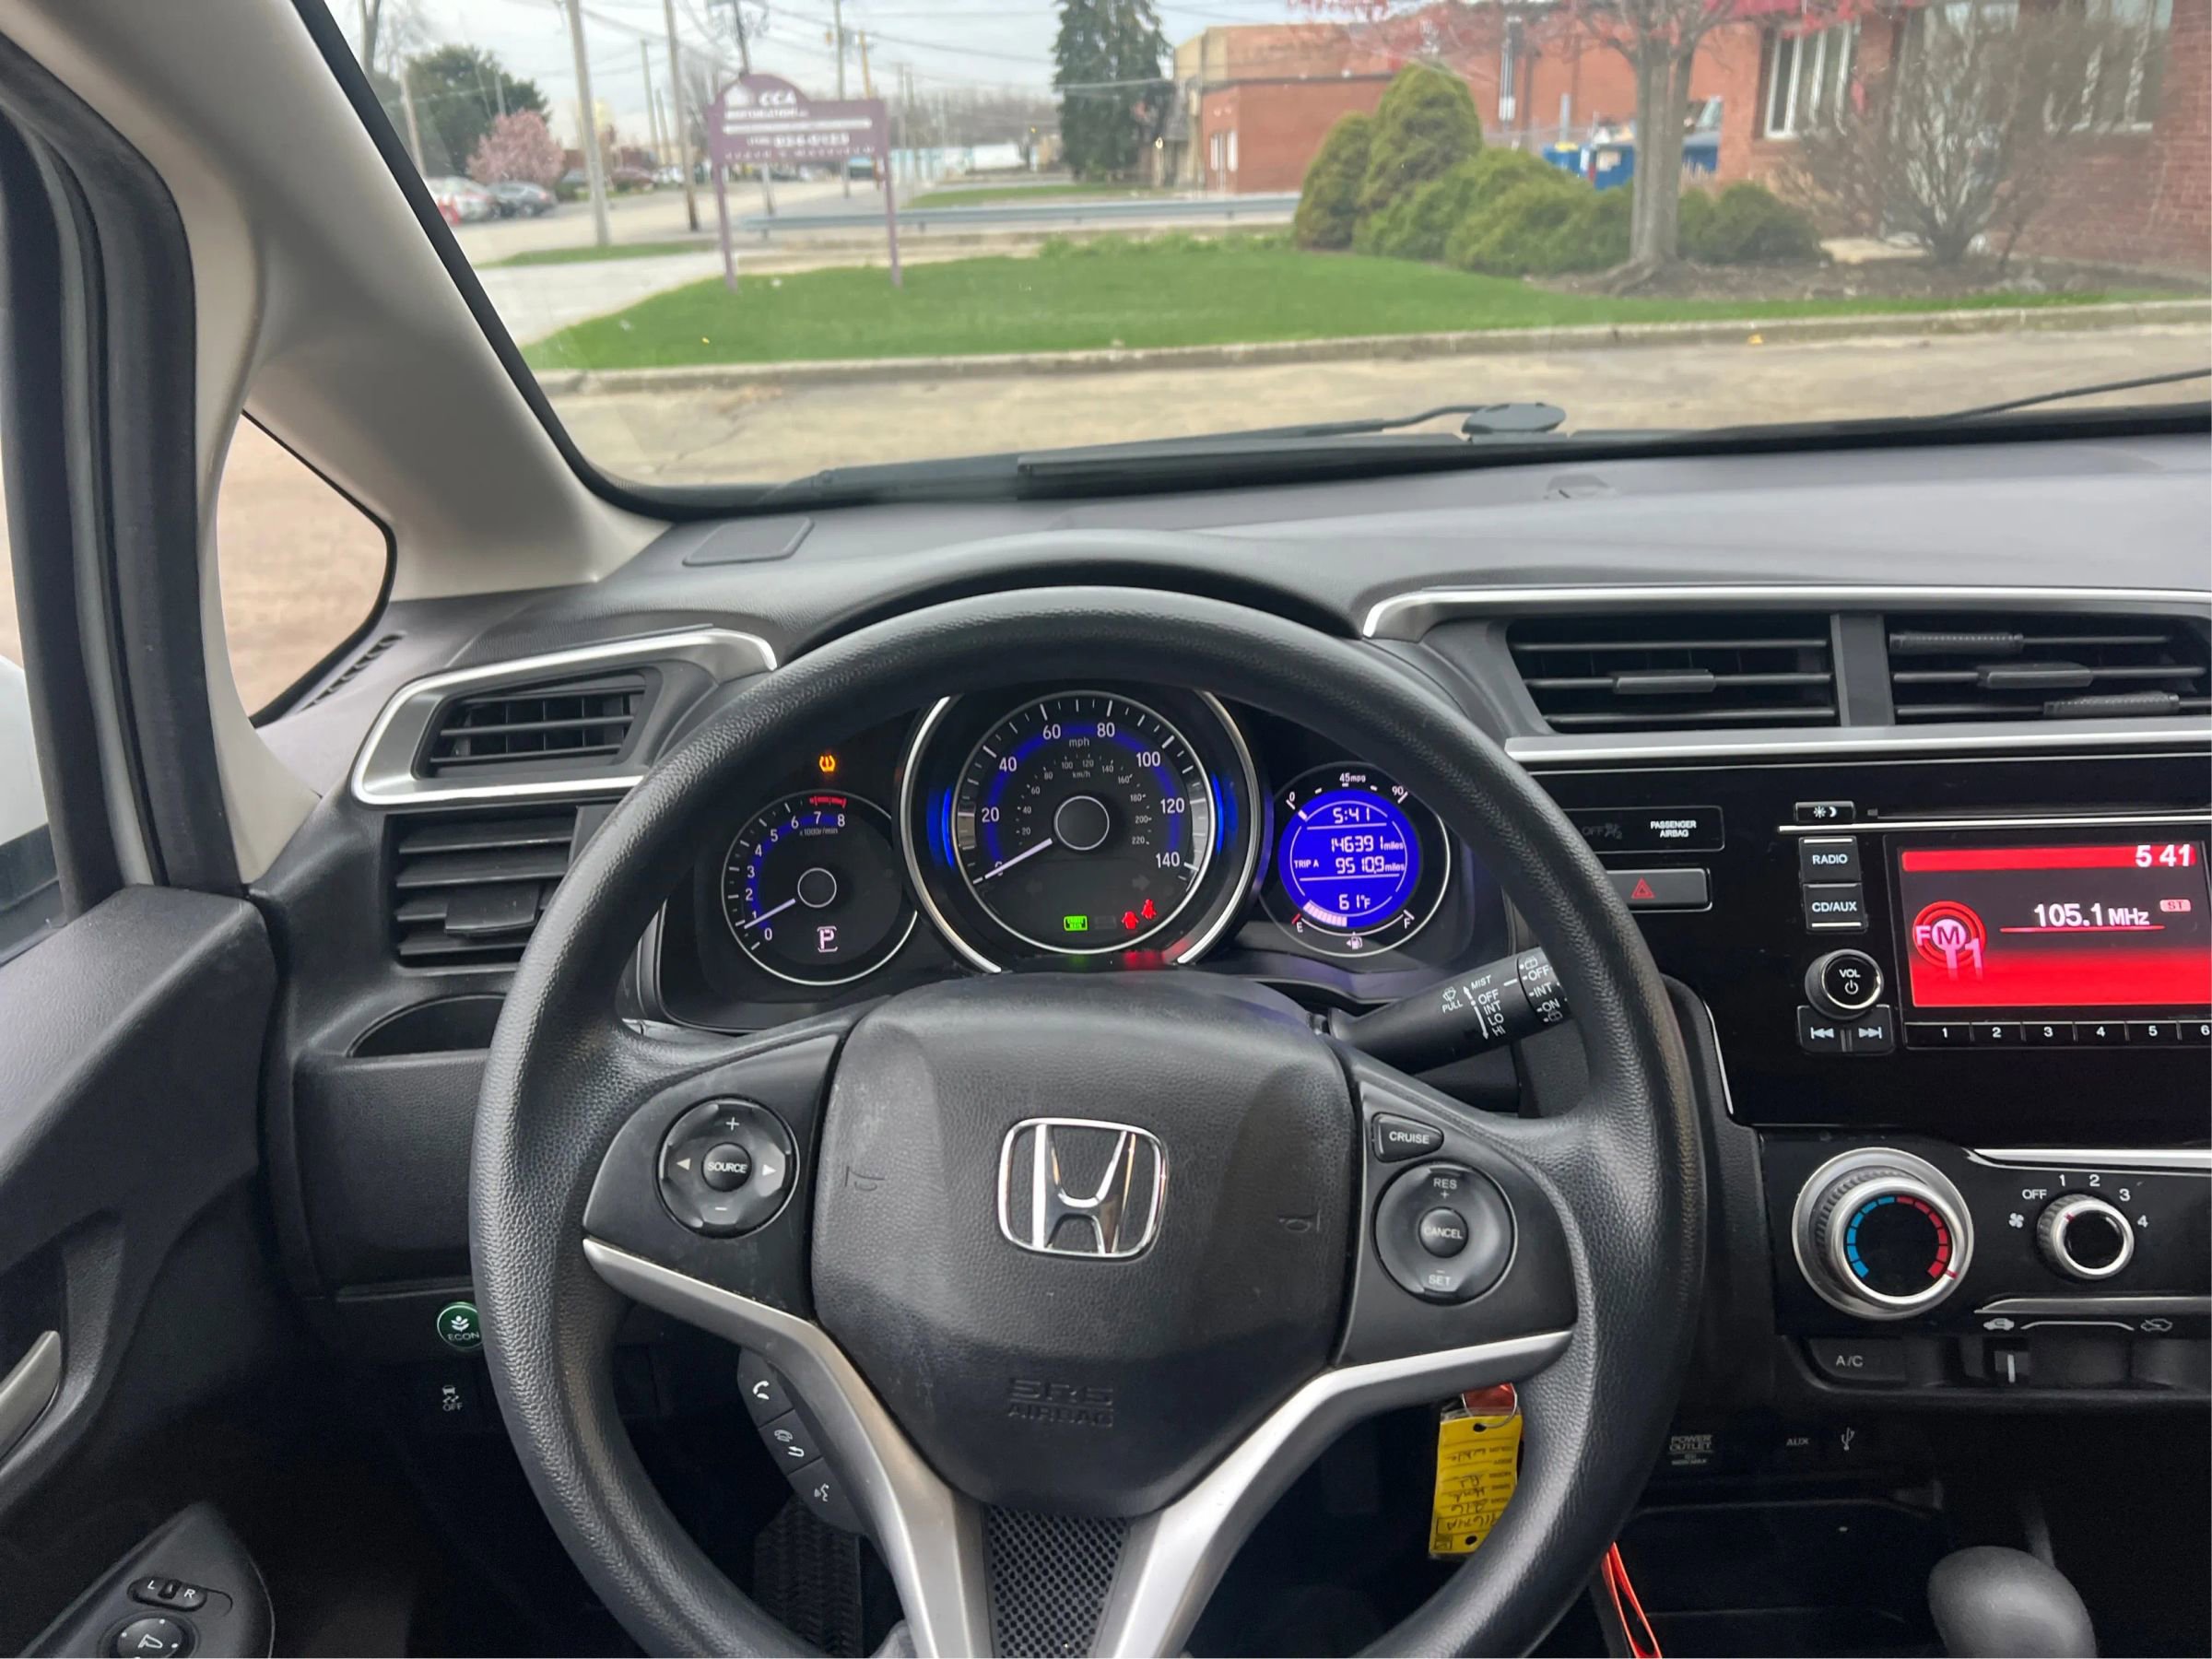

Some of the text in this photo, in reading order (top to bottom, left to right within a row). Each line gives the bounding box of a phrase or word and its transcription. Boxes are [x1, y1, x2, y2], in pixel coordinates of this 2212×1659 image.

[1042, 723, 1062, 740] 60
[1097, 722, 1116, 737] 80
[1069, 737, 1090, 748] mph
[998, 756, 1018, 772] 40
[1062, 761, 1074, 770] 100
[1082, 759, 1095, 768] 120
[1135, 751, 1161, 769] 100
[1072, 771, 1091, 779] km/h
[1102, 765, 1114, 773] 140
[1044, 771, 1053, 780] 80
[1118, 775, 1130, 784] 160
[1030, 786, 1041, 795] 60
[1392, 785, 1404, 796] 90
[1130, 794, 1142, 802] 180
[1288, 792, 1296, 802] 0
[1022, 806, 1031, 814] 40
[1159, 797, 1184, 815] 120
[814, 811, 821, 825] 7
[837, 814, 845, 827] 8
[981, 806, 1000, 824] 20
[1135, 816, 1148, 824] 200
[1333, 806, 1371, 824] 5:41
[791, 815, 799, 829] 6
[1650, 820, 1697, 830] PASSENGER
[771, 829, 779, 842] 5
[1660, 829, 1688, 839] AIRBAG
[1132, 837, 1145, 845] 220
[1383, 841, 1405, 851] miles
[754, 844, 763, 857] 4
[1155, 851, 1181, 868] 140
[1812, 853, 1848, 865] RADIO
[747, 865, 756, 878] 3
[1294, 859, 1312, 869] TRIP
[1312, 859, 1319, 868] A
[1384, 862, 1405, 872] miles
[745, 888, 753, 901] 2
[1812, 901, 1857, 913] CD/AUX
[2033, 902, 2150, 928] 105.1 MHz
[1297, 922, 1303, 933] E
[1403, 919, 1411, 929] F
[764, 927, 772, 941] 0
[818, 929, 835, 949] P
[1527, 964, 1549, 982] OFF
[1839, 968, 1861, 979] VOL
[1470, 974, 1491, 990] MIST
[1533, 982, 1552, 997] INT
[1477, 988, 1500, 1006] OFF
[1441, 999, 1464, 1014] PULL
[1483, 1000, 1501, 1016] INT
[1541, 998, 1560, 1013] ON
[1487, 1013, 1504, 1027] LO
[1491, 1027, 1506, 1037] HI
[1942, 1028, 1948, 1038] 1
[1992, 1027, 2002, 1038] 2
[2043, 1027, 2053, 1038] 3
[2096, 1026, 2105, 1038] 4
[2148, 1025, 2158, 1037] 5
[2200, 1024, 2210, 1036] 6
[1389, 1131, 1430, 1145] CRUISE
[707, 1161, 748, 1173] SOURCE
[1433, 1177, 1457, 1190] RES
[2059, 1174, 2065, 1187] 1
[2089, 1174, 2100, 1187] 2
[2022, 1189, 2048, 1200] OFF
[2119, 1189, 2131, 1202] 3
[2137, 1215, 2148, 1229] 4
[1423, 1226, 1464, 1240] CANCEL
[1429, 1274, 1452, 1286] SET
[447, 1331, 480, 1341] ECON
[1835, 1355, 1864, 1368] A/C
[442, 1402, 464, 1412] OFF
[1671, 1434, 1713, 1443] POWER
[1786, 1438, 1810, 1446] AUX
[1669, 1442, 1712, 1452] OUTLET
[147, 1580, 196, 1599] L R
